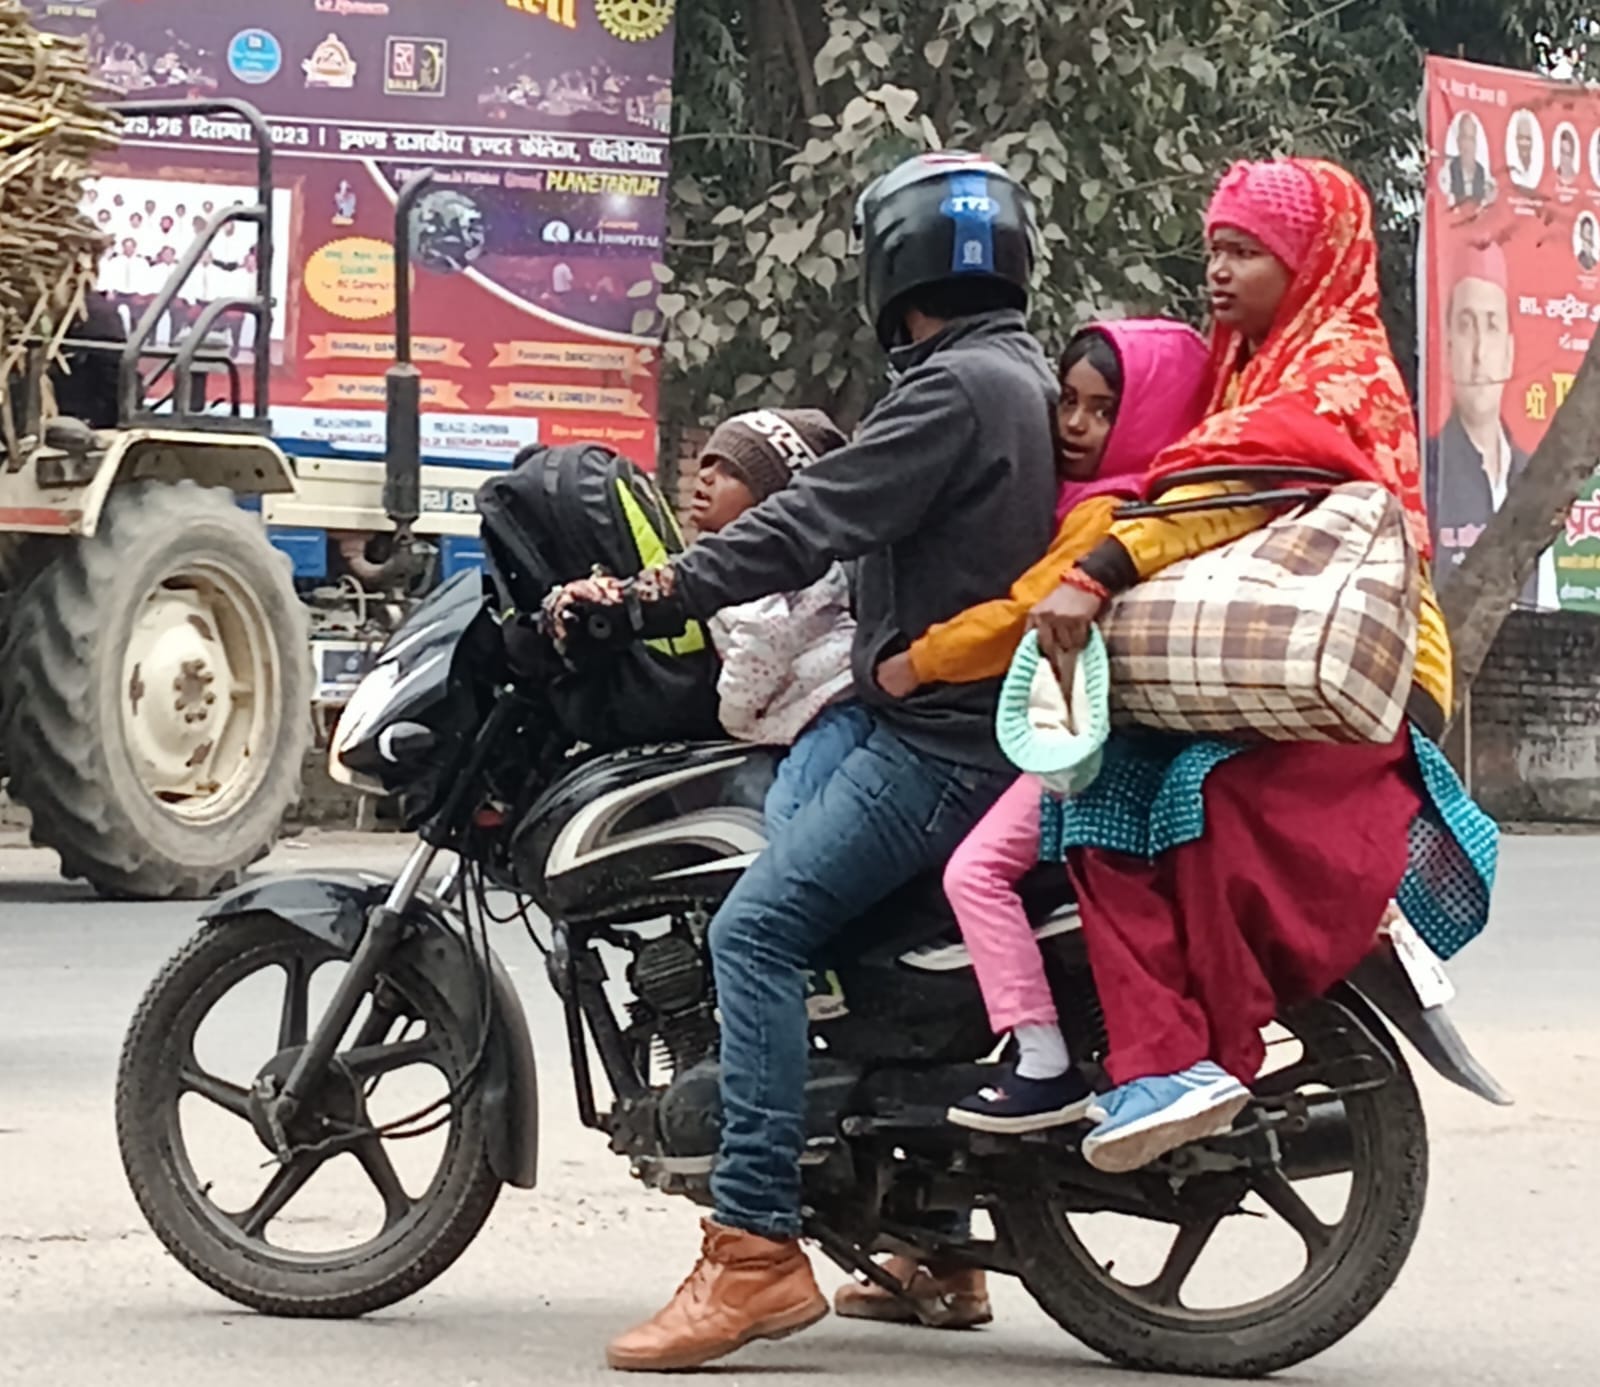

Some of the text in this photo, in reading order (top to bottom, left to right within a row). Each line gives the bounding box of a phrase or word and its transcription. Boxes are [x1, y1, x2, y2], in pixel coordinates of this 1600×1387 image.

[269, 125, 309, 145] 023
[546, 170, 661, 197] PLANETARIUM
[951, 196, 990, 213] TVS
